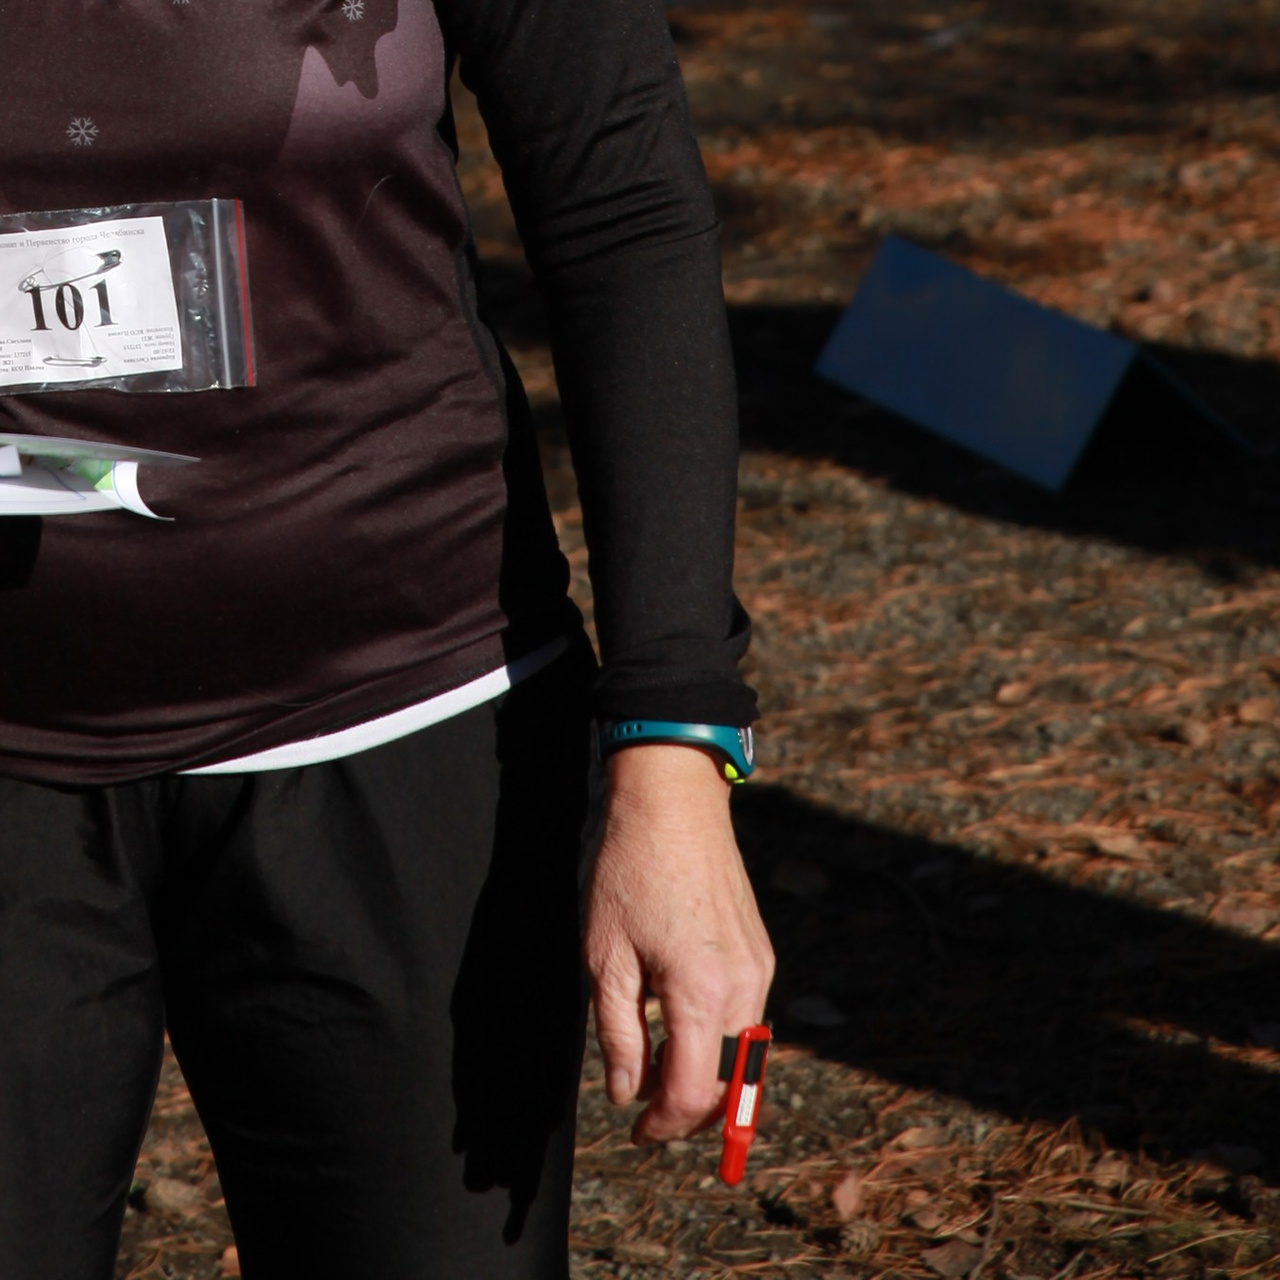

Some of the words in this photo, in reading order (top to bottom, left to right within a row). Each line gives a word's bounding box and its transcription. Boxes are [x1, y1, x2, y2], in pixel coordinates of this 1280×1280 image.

[26, 236, 70, 248] Первенство
[72, 233, 99, 244] города
[23, 278, 119, 332] 101
